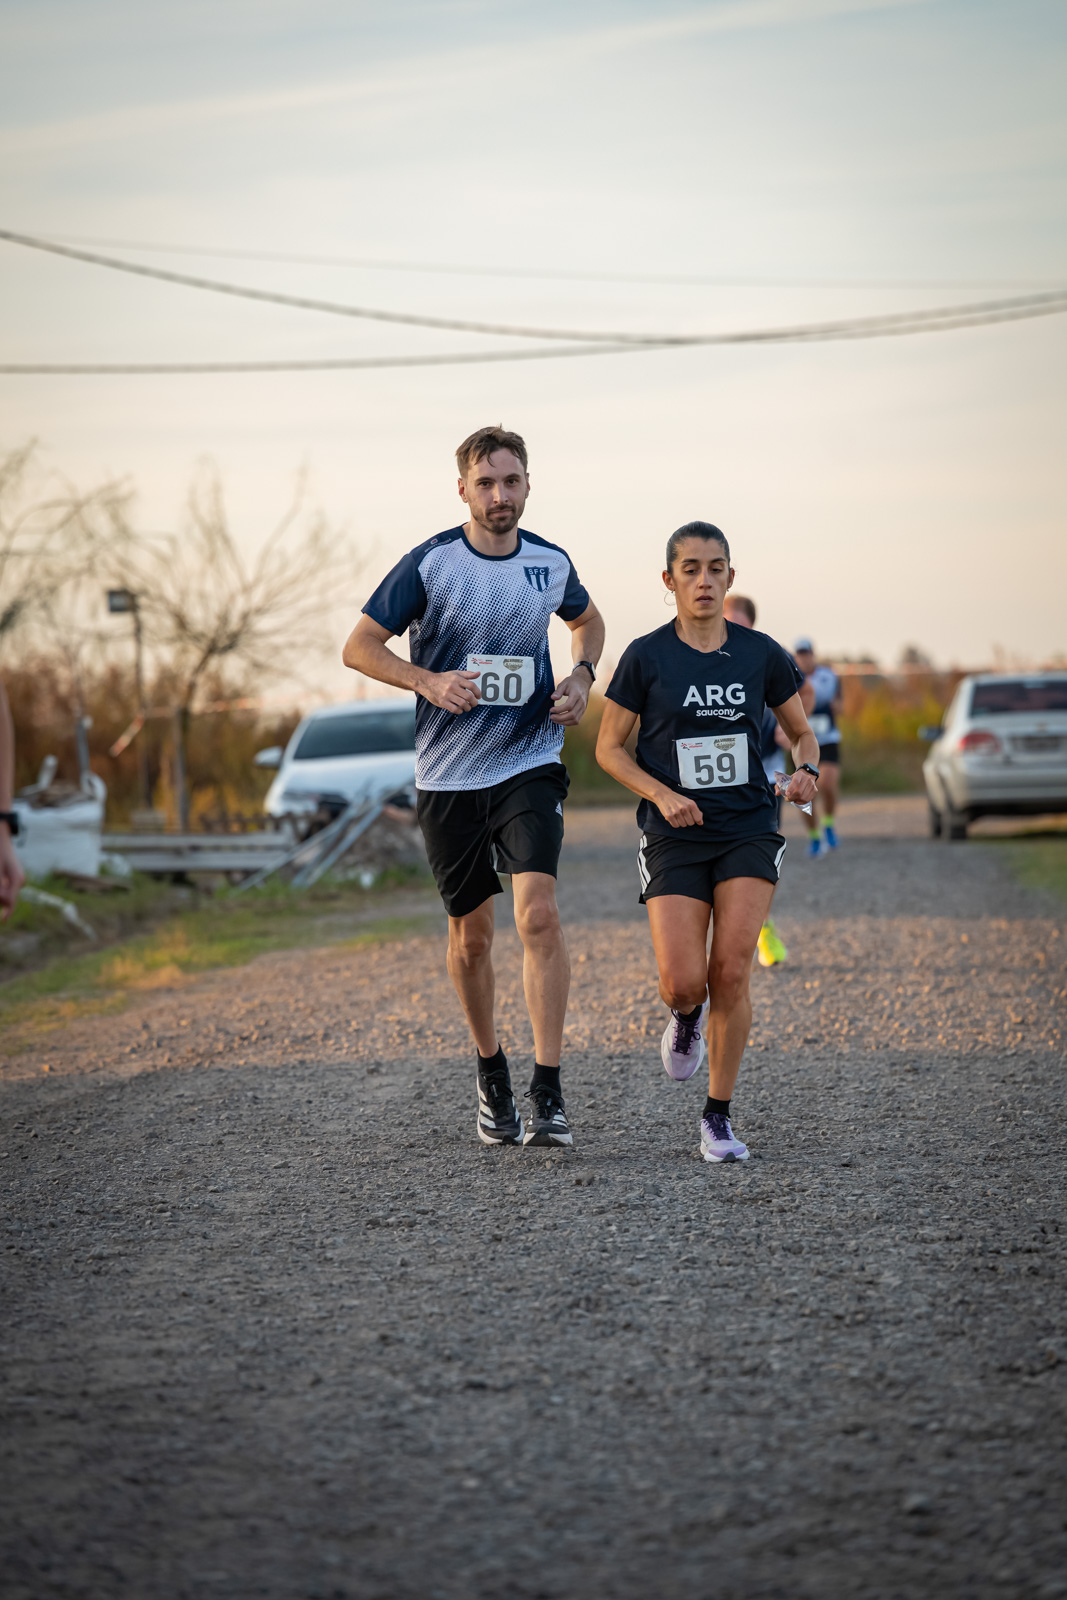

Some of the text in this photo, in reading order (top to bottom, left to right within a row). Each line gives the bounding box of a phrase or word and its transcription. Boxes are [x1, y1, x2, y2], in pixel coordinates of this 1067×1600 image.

[481, 672, 522, 703] 60
[682, 683, 746, 707] ARG
[696, 708, 736, 717] saucony
[694, 752, 736, 786] 59
